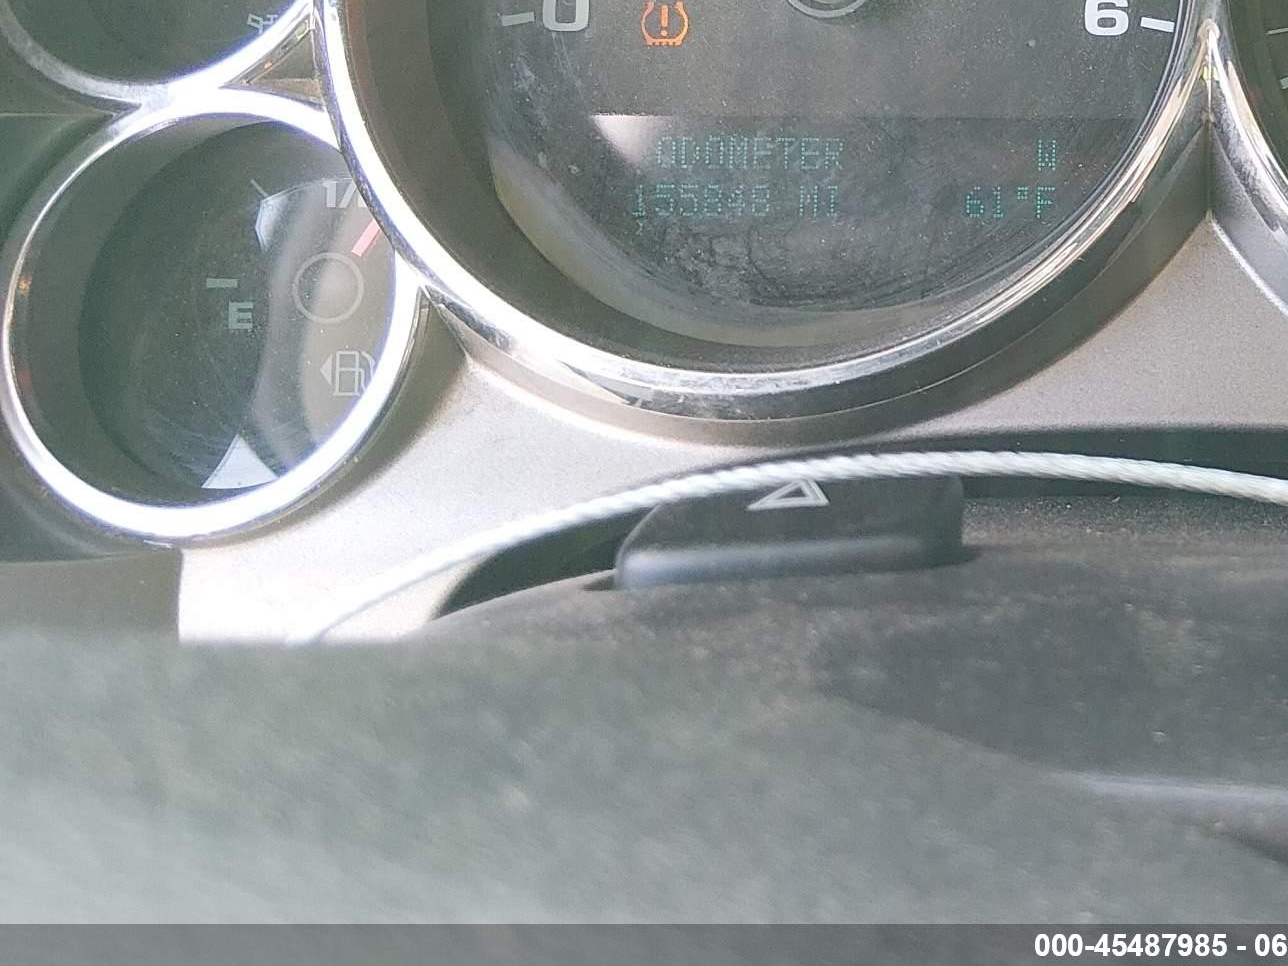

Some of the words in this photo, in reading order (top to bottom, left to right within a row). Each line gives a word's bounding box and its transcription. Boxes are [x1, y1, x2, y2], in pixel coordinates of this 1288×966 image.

[656, 136, 844, 170] ODOMETER
[799, 185, 839, 217] MI
[228, 302, 254, 329] E
